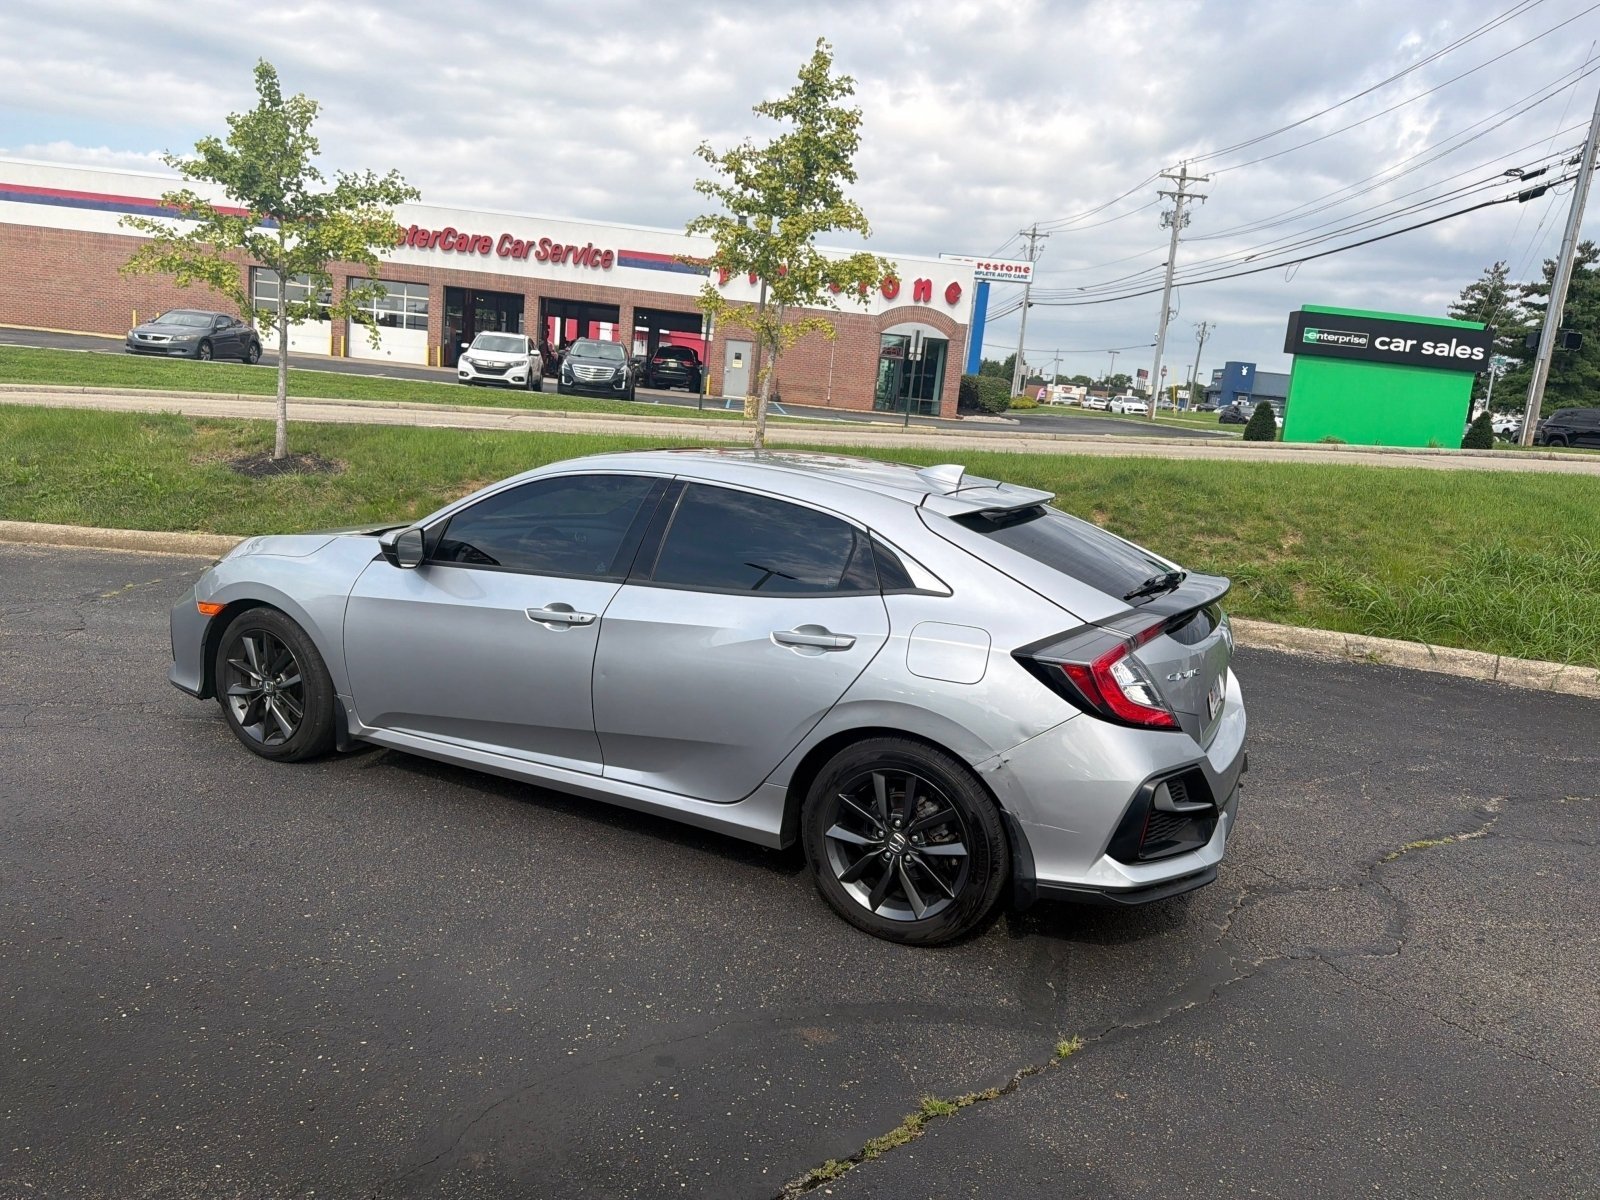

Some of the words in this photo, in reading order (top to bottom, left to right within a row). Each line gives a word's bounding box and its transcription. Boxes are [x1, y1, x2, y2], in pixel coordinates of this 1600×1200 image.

[396, 224, 493, 255] sterCare
[496, 233, 536, 259] Car
[535, 237, 615, 269] Service
[1306, 331, 1367, 345] enterprise
[1374, 336, 1417, 353] car
[1421, 338, 1485, 360] sales
